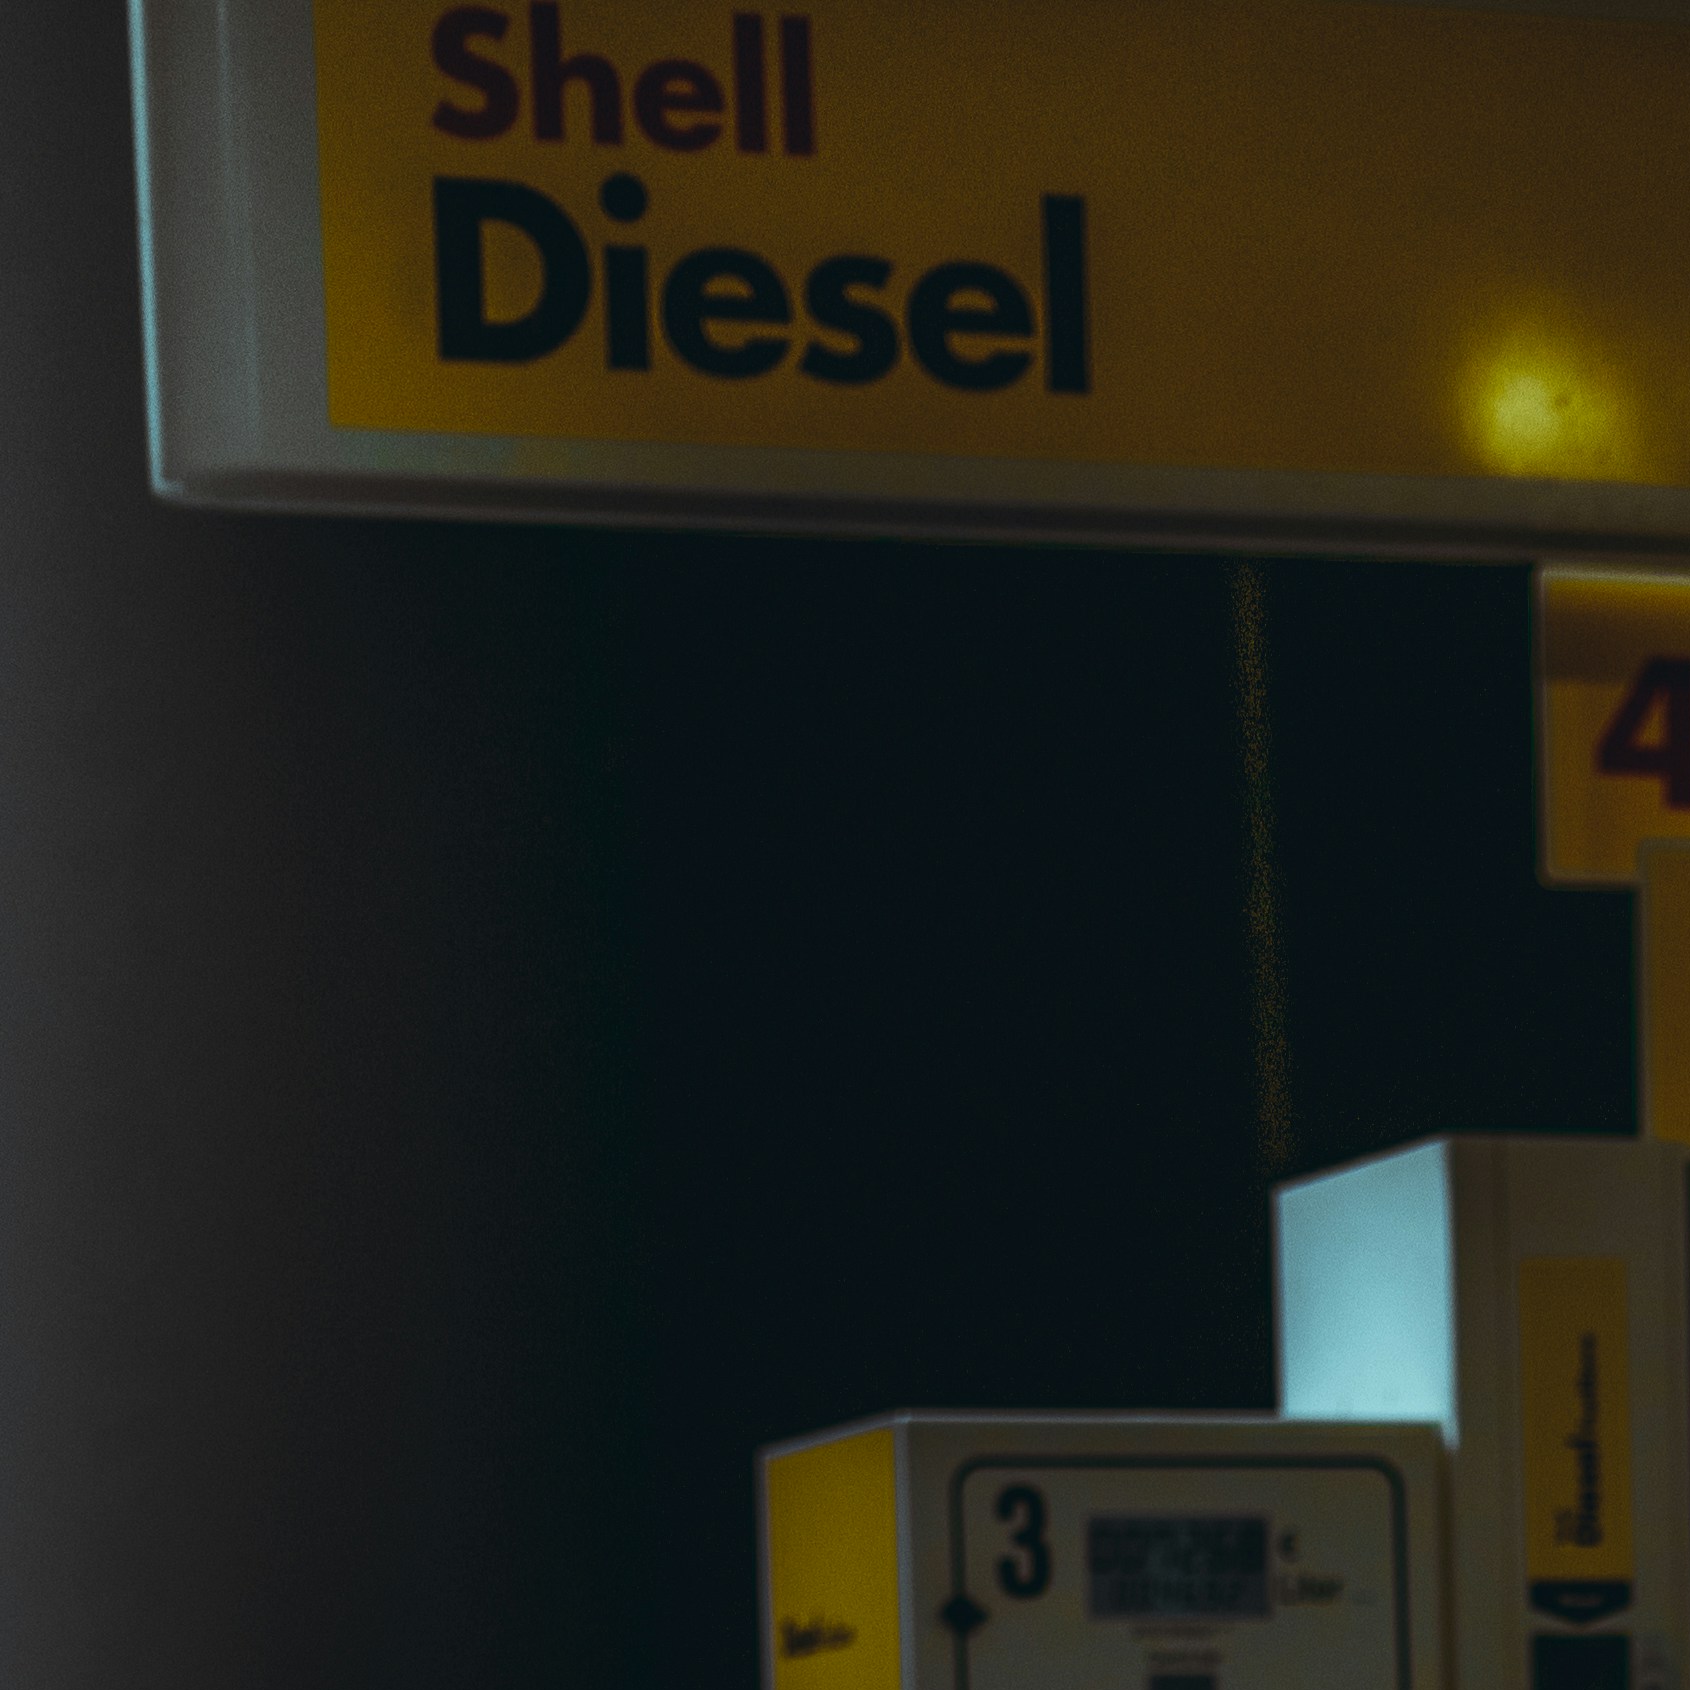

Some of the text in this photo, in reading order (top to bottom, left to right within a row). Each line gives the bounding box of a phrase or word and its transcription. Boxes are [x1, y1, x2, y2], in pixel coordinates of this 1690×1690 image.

[431, 0, 815, 156] Shell
[432, 172, 1090, 393] Diesel
[995, 1485, 1051, 1598] 3
